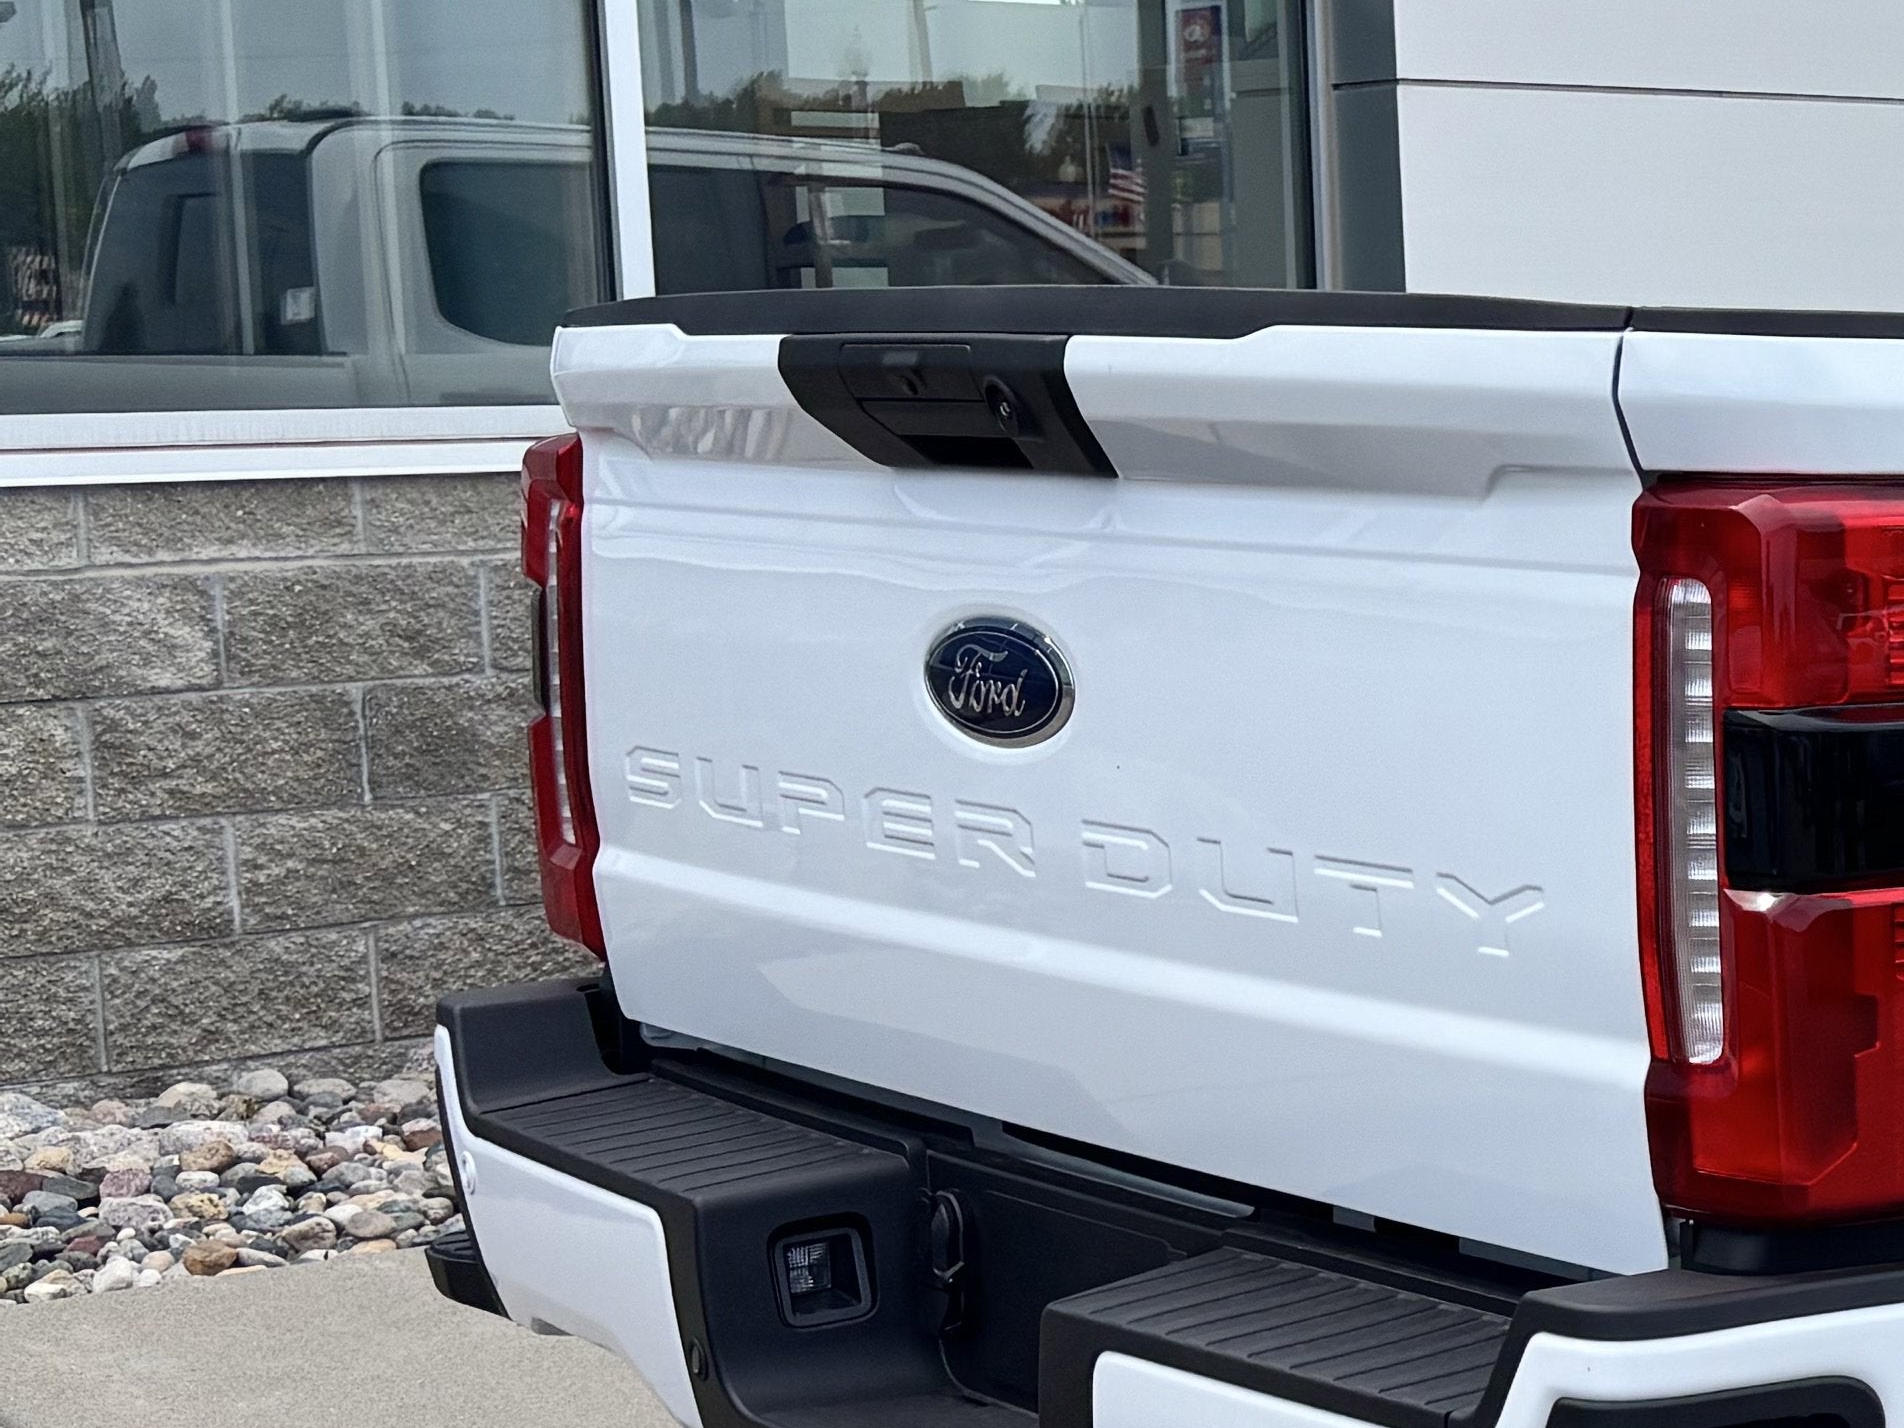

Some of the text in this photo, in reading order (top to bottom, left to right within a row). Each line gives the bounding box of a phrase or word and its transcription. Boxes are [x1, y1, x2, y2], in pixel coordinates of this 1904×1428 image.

[947, 643, 1028, 717] Ford
[623, 744, 1545, 958] SUPER DUTY
